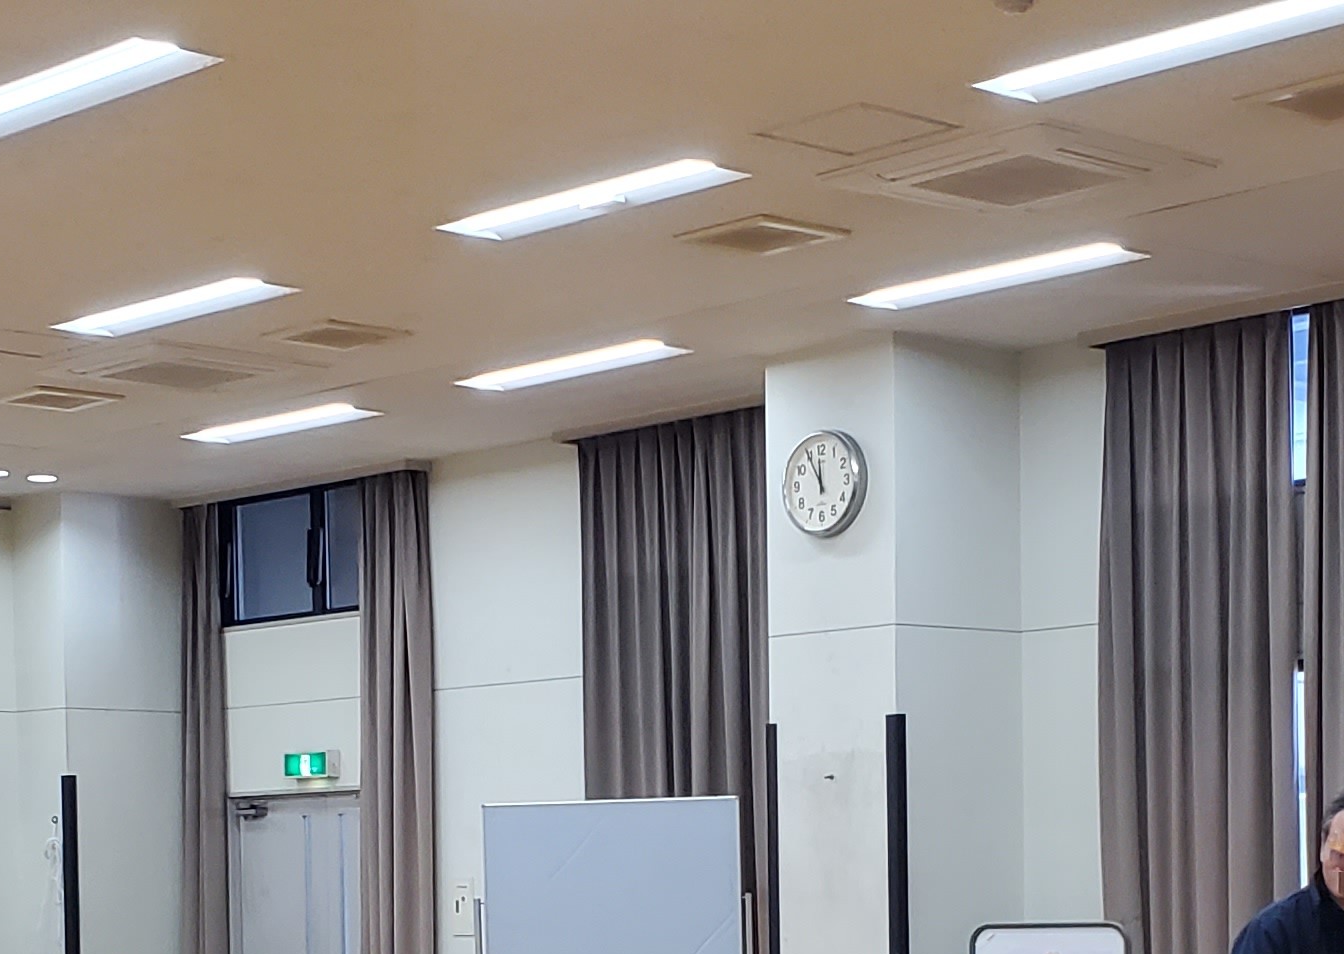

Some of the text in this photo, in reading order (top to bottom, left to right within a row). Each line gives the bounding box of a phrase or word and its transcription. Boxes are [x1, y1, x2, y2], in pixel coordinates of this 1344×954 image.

[817, 444, 826, 456] 12
[840, 457, 846, 469] 2
[797, 464, 806, 476] 10
[843, 474, 850, 485] 3
[794, 481, 800, 493] 9
[839, 491, 845, 502] 4
[798, 498, 805, 510] 8
[808, 508, 814, 520] 7
[819, 511, 825, 522] 6
[831, 505, 837, 516] 5
